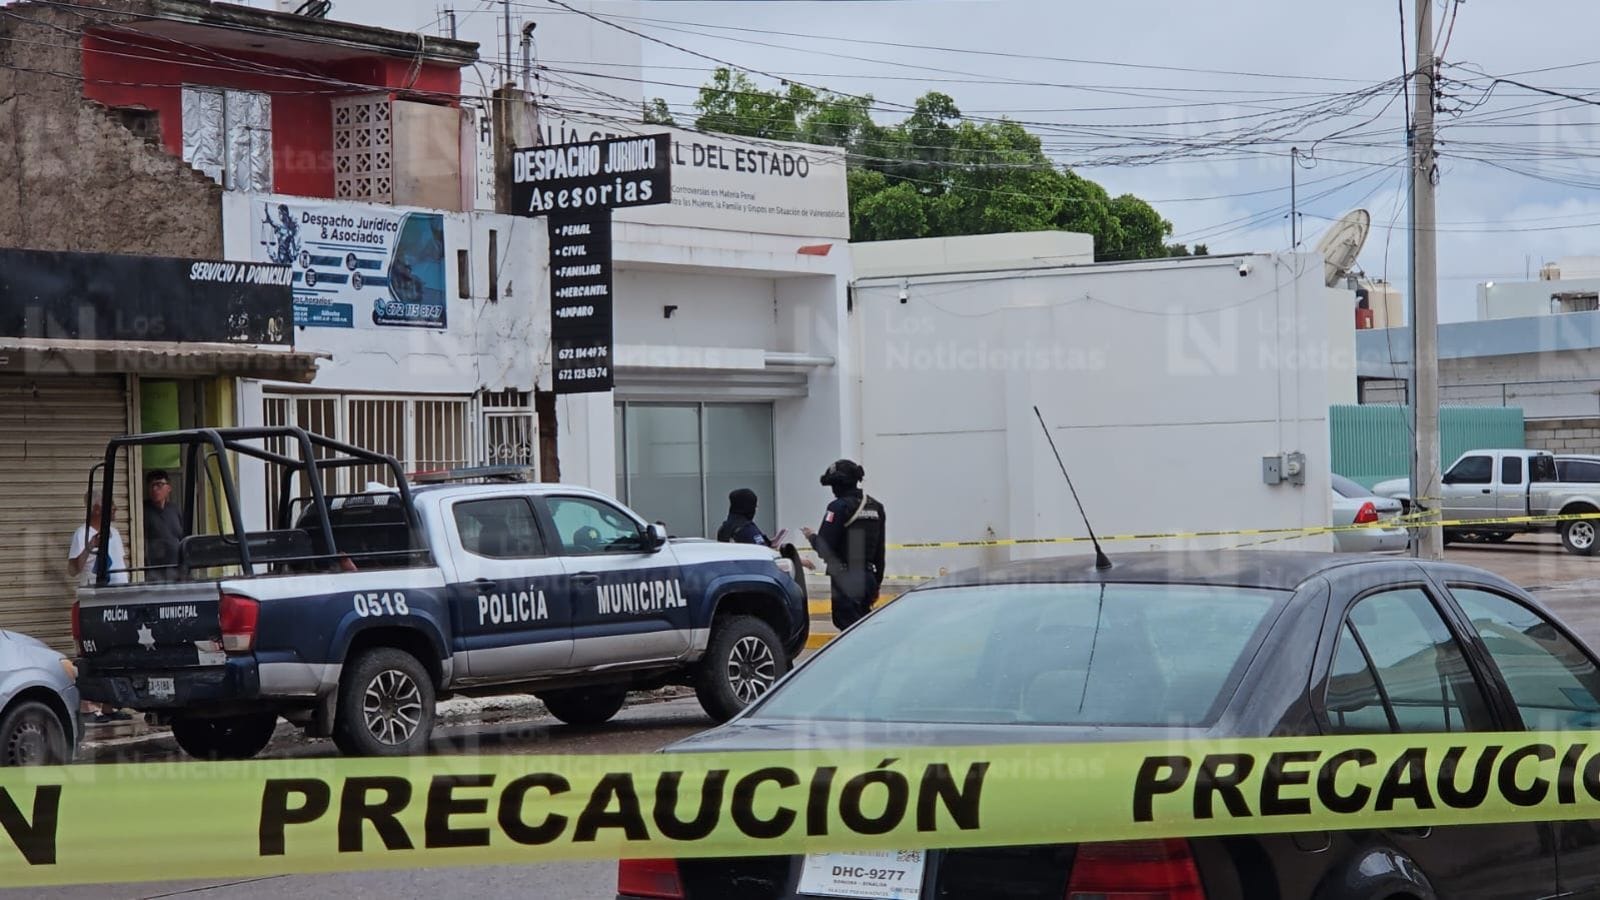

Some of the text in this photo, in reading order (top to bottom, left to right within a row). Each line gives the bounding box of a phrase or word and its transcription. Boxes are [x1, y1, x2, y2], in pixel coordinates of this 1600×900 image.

[514, 147, 599, 184] DESPACHO
[604, 138, 656, 172] JURIDICO
[693, 142, 728, 170] DEL
[736, 149, 809, 179] ESTADO
[529, 178, 652, 212] Asesorias
[302, 211, 398, 232] Despacho Jurídico
[321, 227, 384, 245] & Asociados
[562, 224, 591, 236] PENAL
[562, 245, 587, 257] CIVIL
[190, 262, 293, 286] SERVICIO A DOMICILIO
[561, 264, 601, 277] FAMILIAR
[560, 284, 608, 298] MERCANTIL
[387, 302, 404, 316] 672
[420, 304, 443, 318] 8747
[560, 306, 594, 318] AMPARO
[559, 348, 574, 360] 672
[558, 368, 573, 380] 672
[353, 591, 409, 618] 0518
[478, 578, 687, 626] POLICÍA MUNICIPAL
[159, 605, 198, 619] MUNICIPAL
[259, 754, 990, 856] PRECAUCIÓN
[831, 865, 906, 881] DHC-9277
